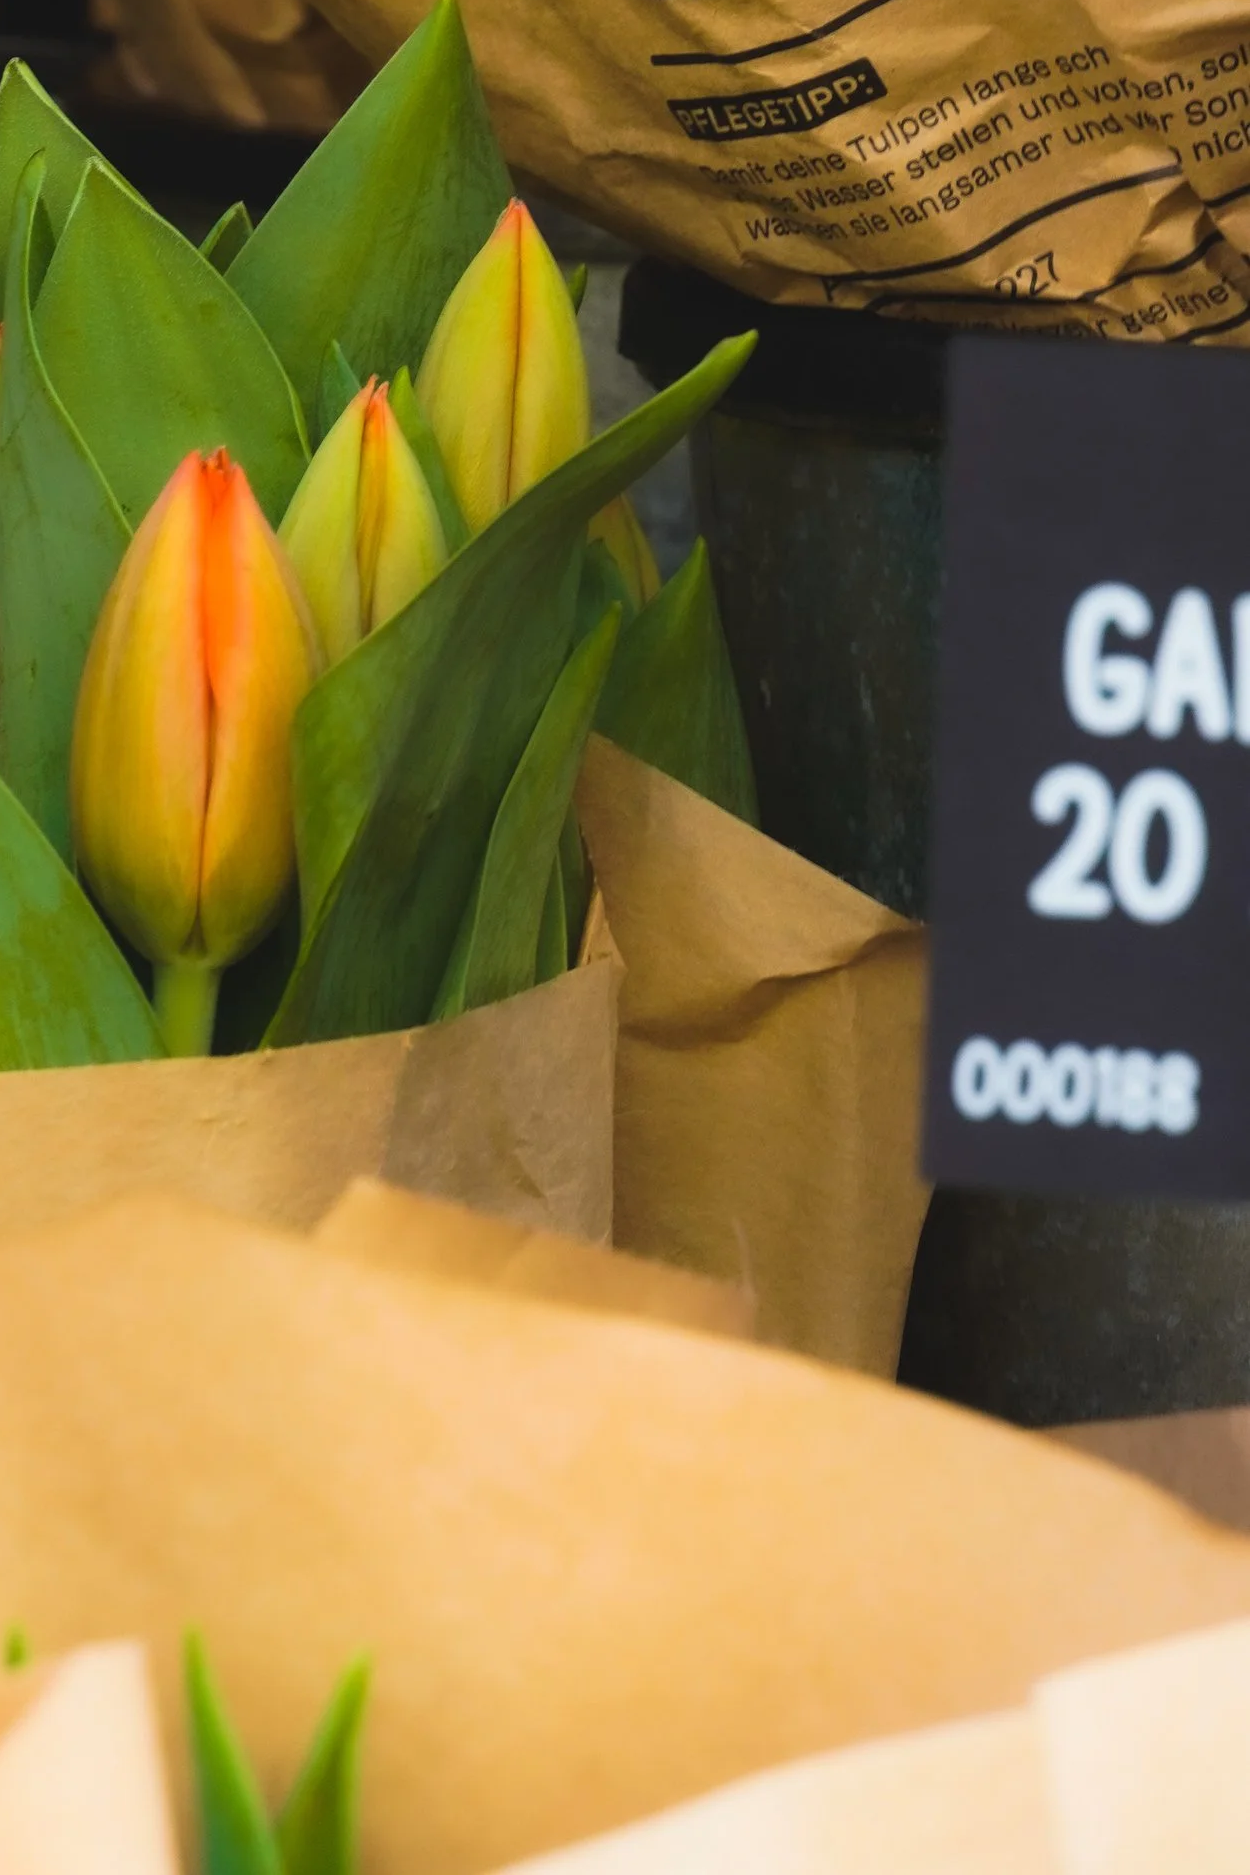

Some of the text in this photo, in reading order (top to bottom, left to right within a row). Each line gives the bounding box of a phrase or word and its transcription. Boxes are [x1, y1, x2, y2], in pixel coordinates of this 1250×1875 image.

[676, 73, 875, 135] PFLEGETIPP:
[774, 153, 847, 182] deine
[846, 95, 960, 163] Tulpen
[963, 57, 1051, 106] lange
[796, 170, 898, 213] Wasser
[905, 111, 1014, 180] stellen
[1018, 84, 1080, 121] und
[850, 211, 890, 238] sie
[890, 132, 1053, 228] langsamer
[1063, 111, 1124, 146] und
[1027, 762, 1209, 925] 20
